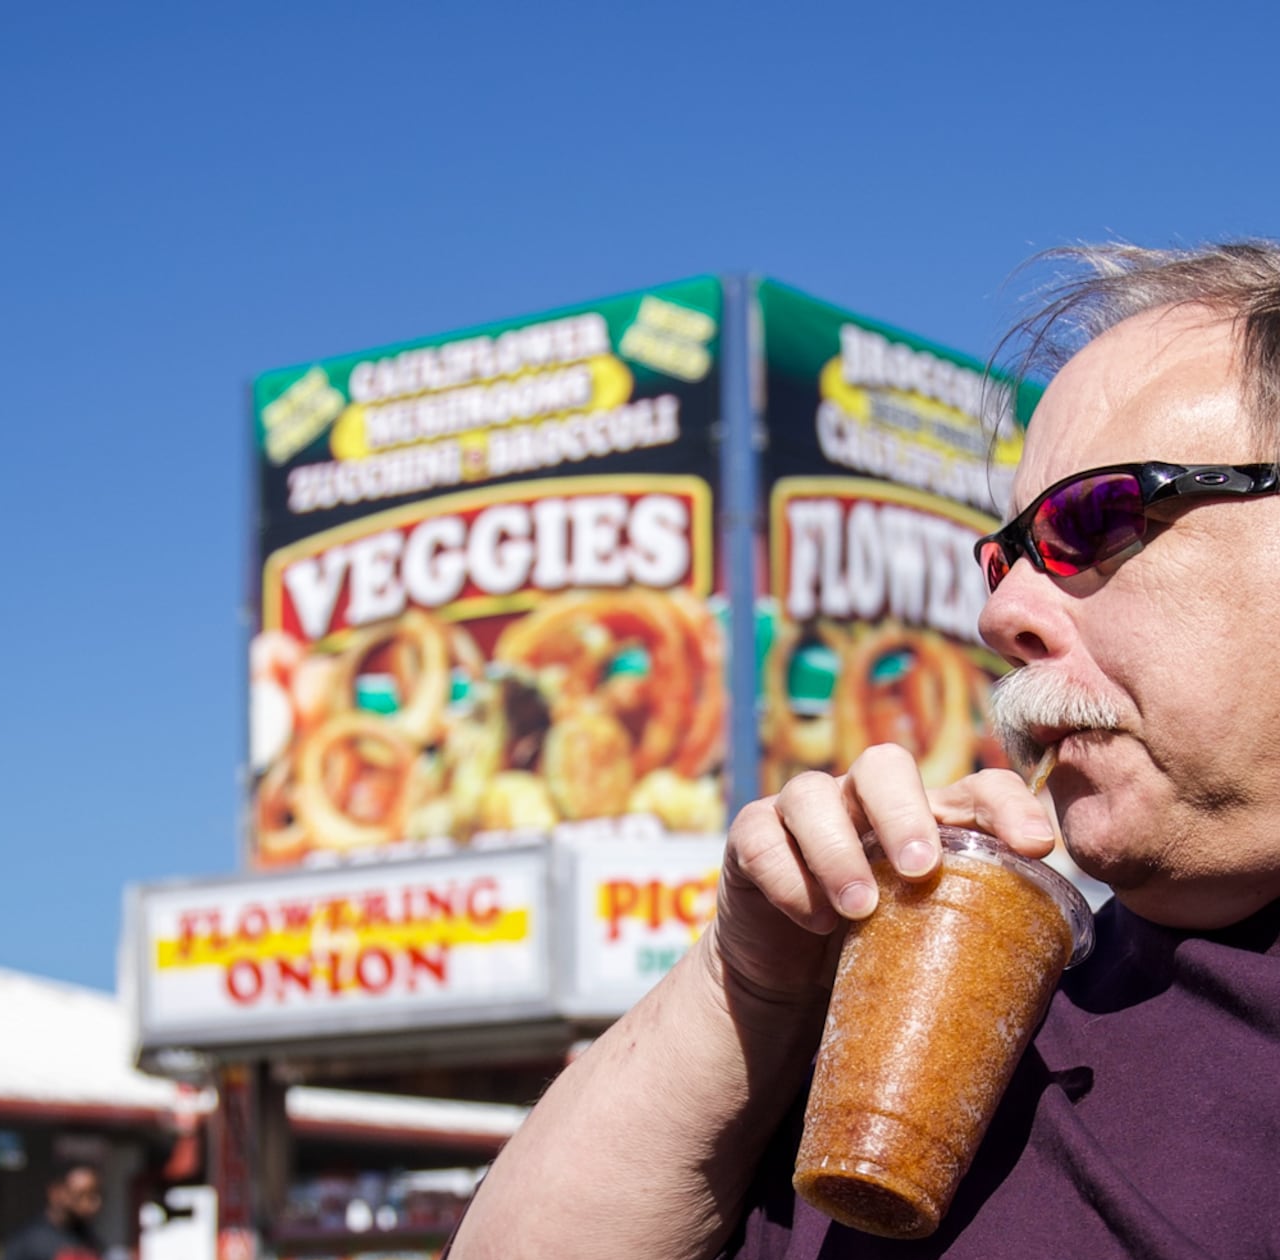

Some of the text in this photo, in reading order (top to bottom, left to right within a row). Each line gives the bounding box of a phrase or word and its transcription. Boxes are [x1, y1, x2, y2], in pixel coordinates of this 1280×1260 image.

[284, 494, 690, 640] VEGGIES
[178, 876, 501, 958] FLOWERING
[225, 944, 449, 1006] ONION
